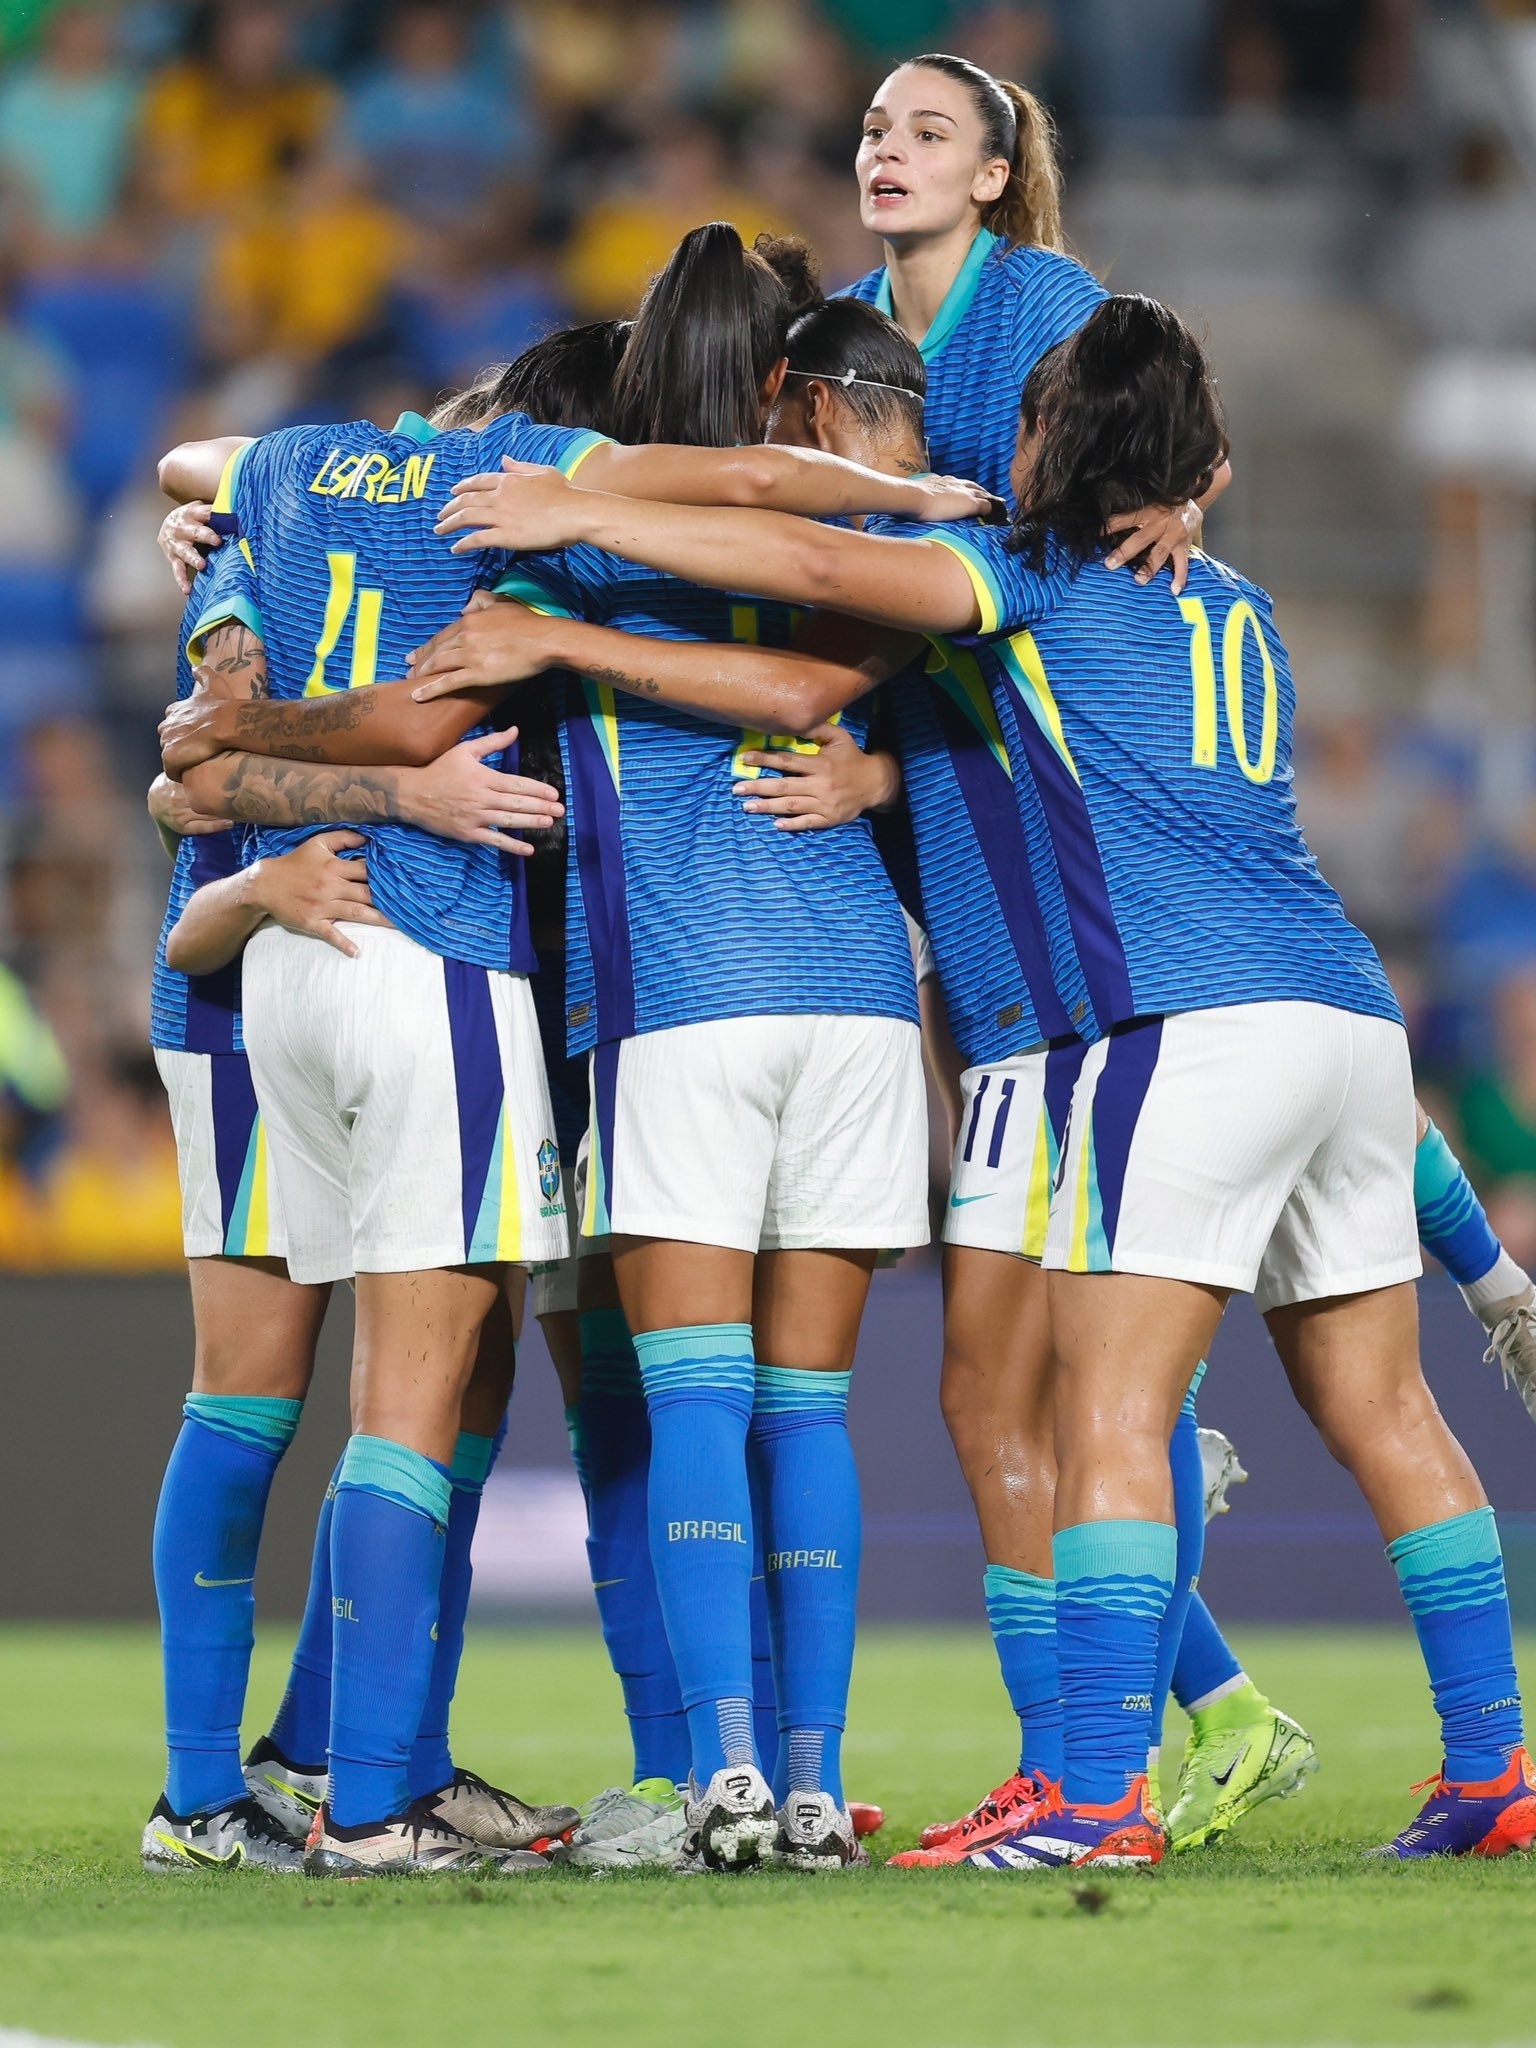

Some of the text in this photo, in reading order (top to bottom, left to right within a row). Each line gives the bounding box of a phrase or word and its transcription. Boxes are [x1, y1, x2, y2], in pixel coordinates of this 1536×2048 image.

[302, 551, 384, 698] 4
[1176, 596, 1278, 785] 10
[963, 1074, 1016, 1169] 11
[540, 1203, 567, 1217] BRASIL
[668, 1520, 747, 1544] BRASIL
[768, 1550, 842, 1572] BRASIL
